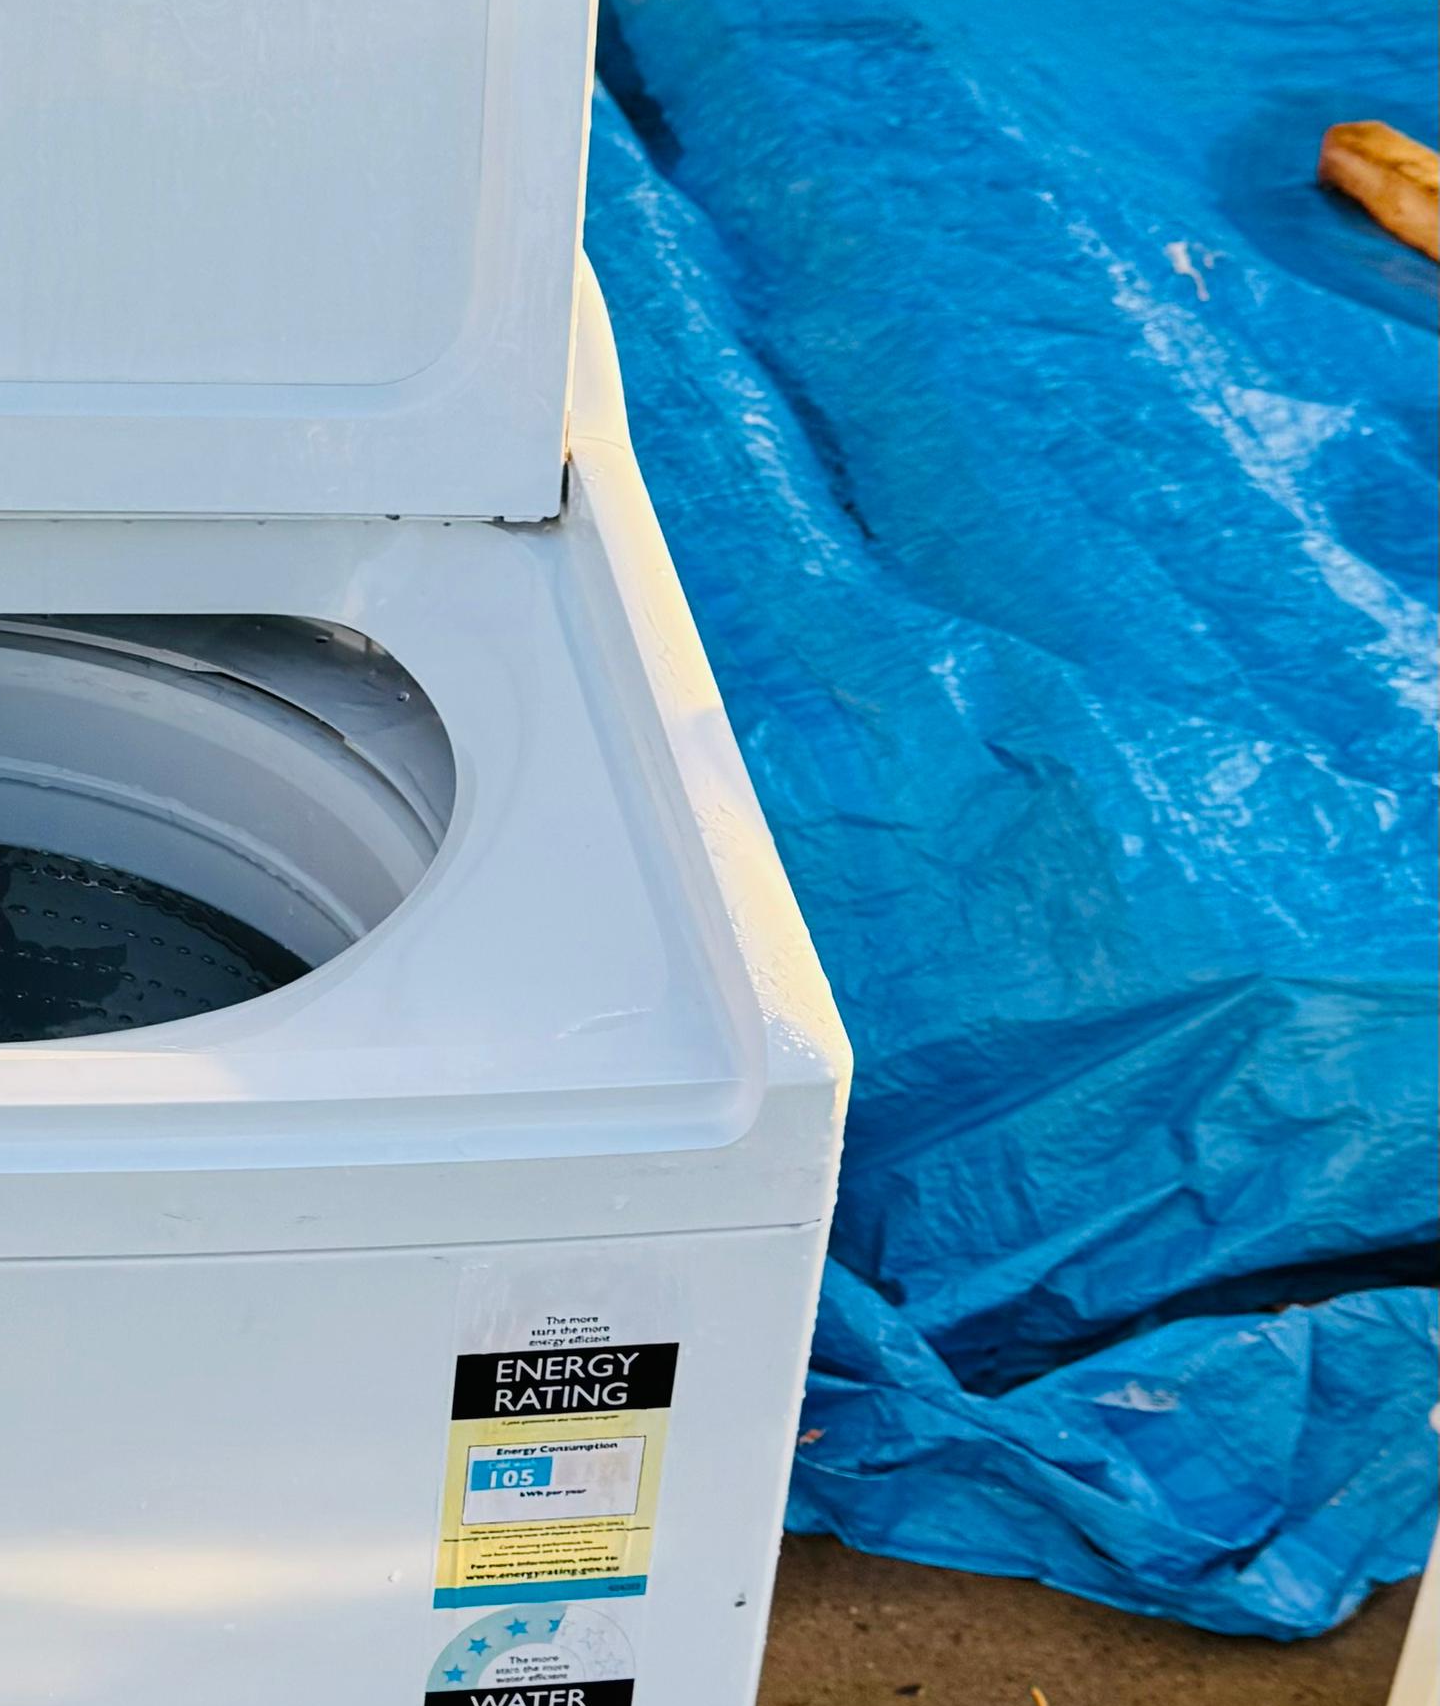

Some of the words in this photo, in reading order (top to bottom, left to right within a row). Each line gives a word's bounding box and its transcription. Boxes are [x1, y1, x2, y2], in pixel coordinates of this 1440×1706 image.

[546, 1316, 566, 1325] The
[569, 1316, 599, 1324] more
[560, 1326, 578, 1335] the
[581, 1325, 610, 1333] more
[568, 1335, 610, 1344] efficient
[495, 1351, 640, 1384] ENERGY
[493, 1382, 629, 1412] RATING
[497, 1447, 536, 1456] Energy
[540, 1442, 618, 1453] Consumption
[490, 1469, 535, 1488] 105
[565, 1488, 587, 1496] year
[510, 1656, 528, 1664] The
